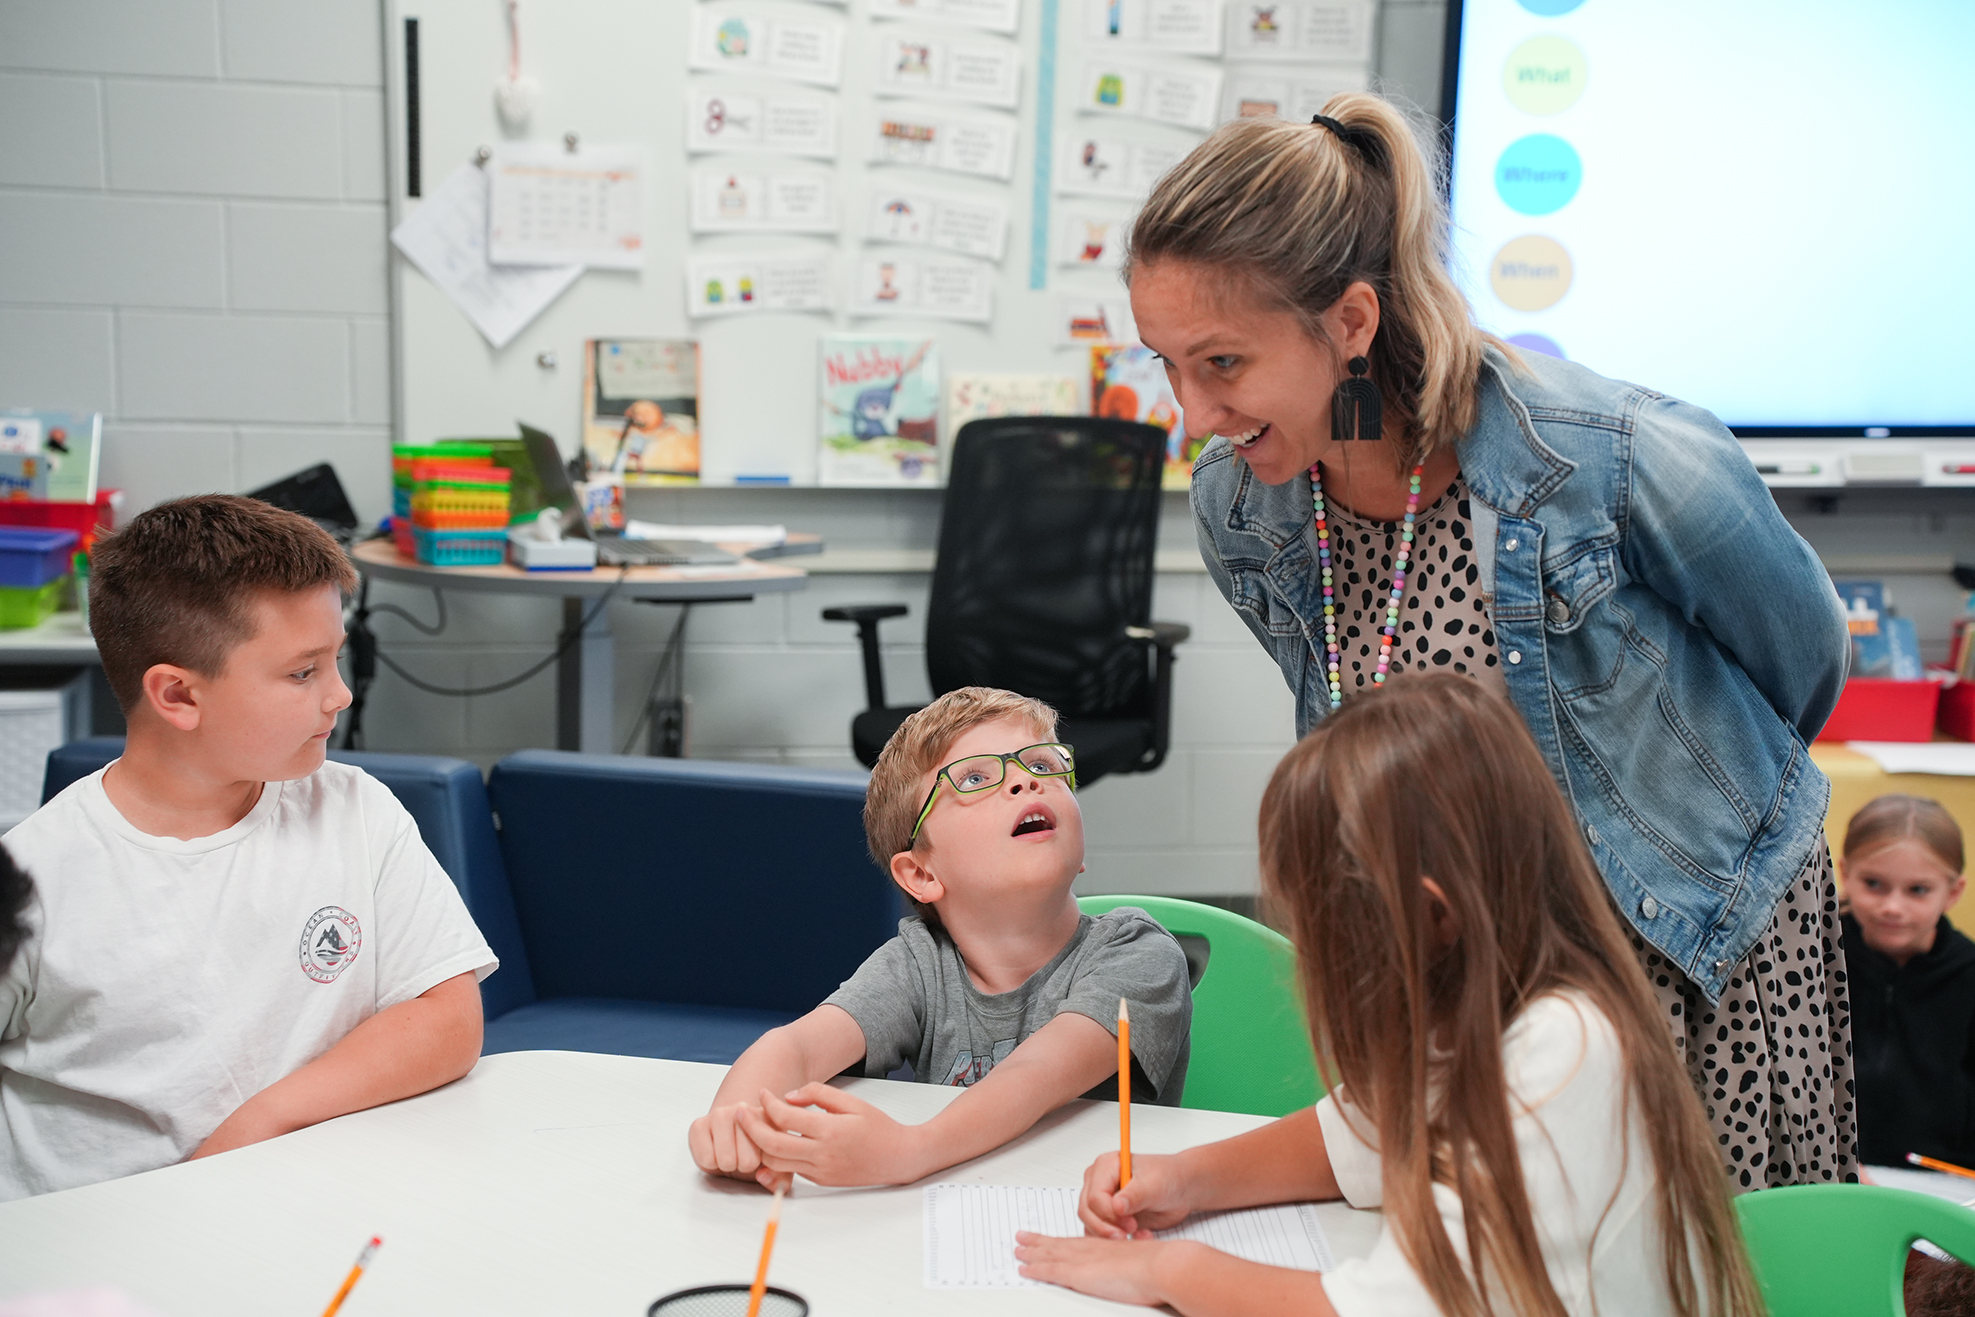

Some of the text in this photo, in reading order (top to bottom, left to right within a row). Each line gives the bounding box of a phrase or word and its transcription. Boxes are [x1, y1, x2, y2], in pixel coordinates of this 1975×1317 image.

[1518, 66, 1571, 82] What
[1503, 167, 1568, 183] Where
[1500, 263, 1558, 279] When
